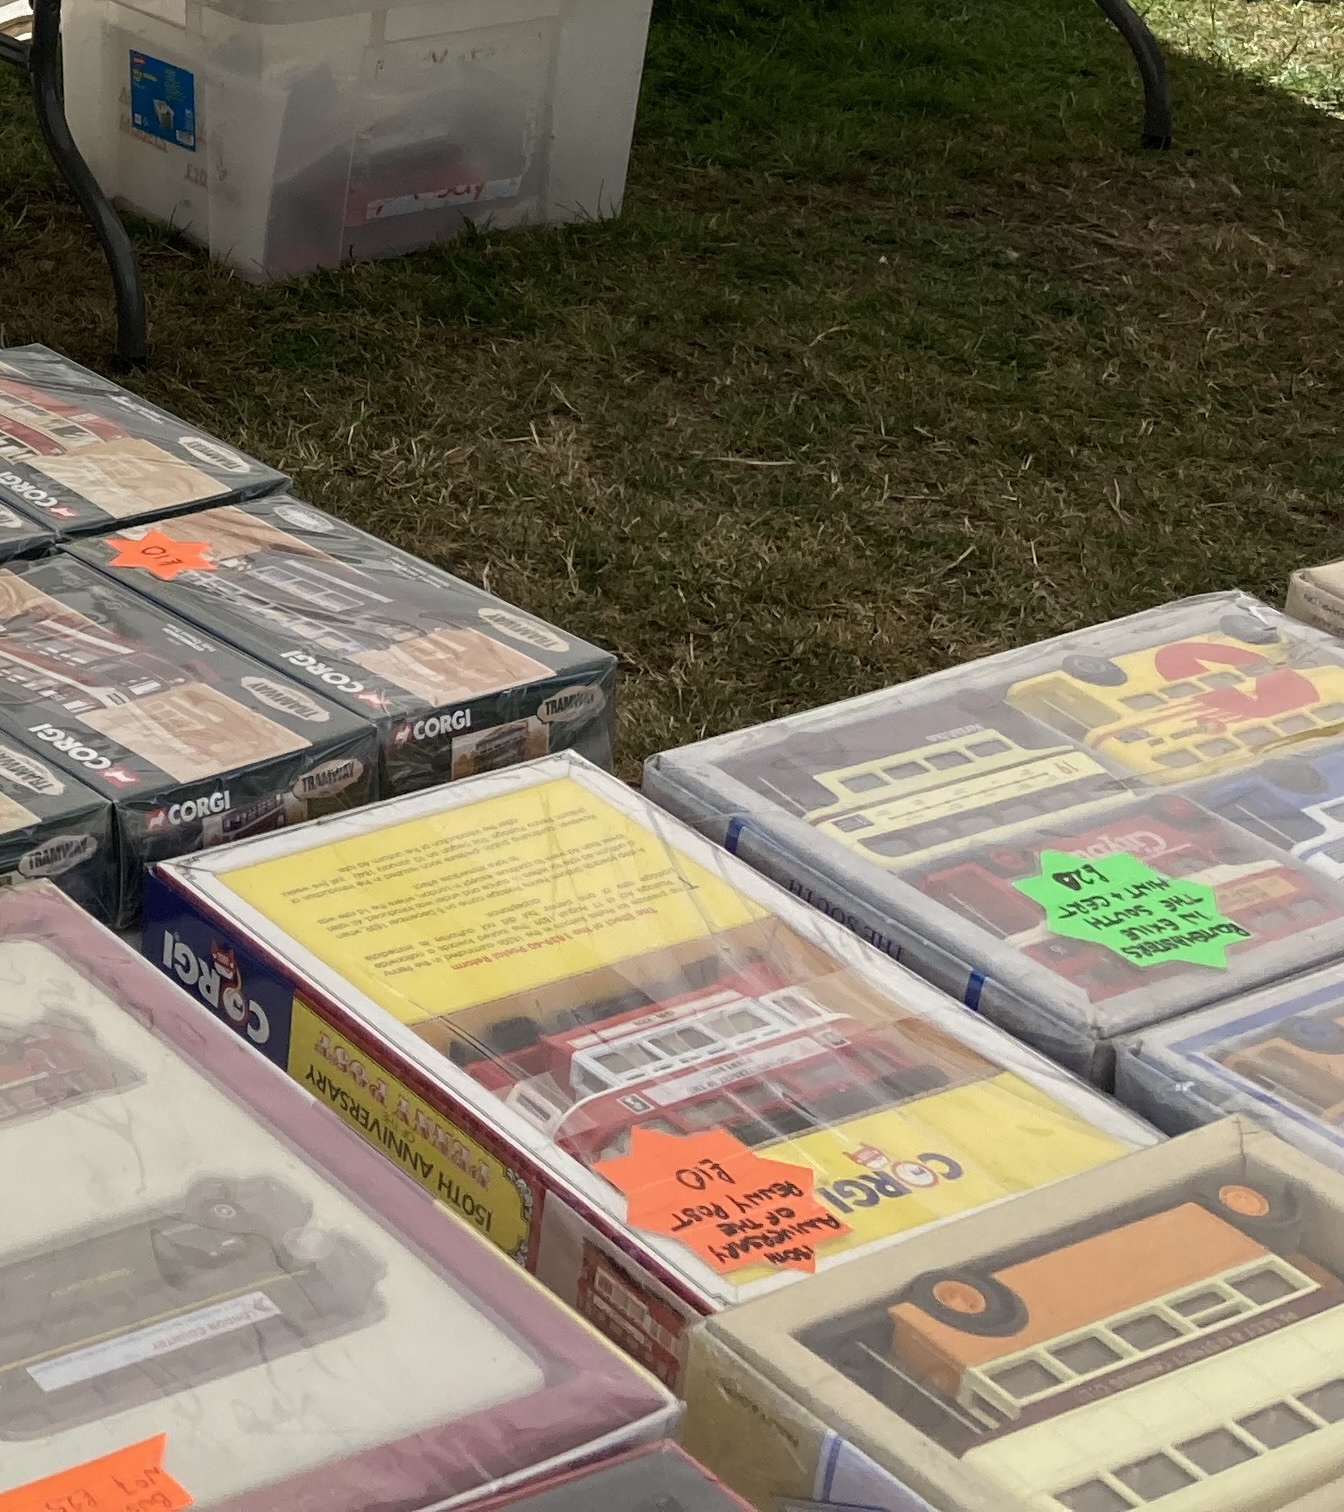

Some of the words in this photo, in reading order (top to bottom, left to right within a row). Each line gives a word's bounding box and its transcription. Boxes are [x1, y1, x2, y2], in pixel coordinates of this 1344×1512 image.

[141, 545, 183, 568] £10
[485, 610, 562, 651] TRAMWAY
[280, 650, 364, 694] CORGI
[247, 678, 323, 721] TRAMWAY
[543, 689, 600, 720] TRAMWAY
[413, 708, 472, 741] CORGI
[27, 722, 112, 771] CORGI
[301, 760, 358, 796] TRAMWAY
[167, 790, 231, 827] CORGI
[1089, 902, 1155, 932] SOUTH
[1158, 893, 1205, 912] THE
[162, 928, 271, 1045] CORGI
[304, 1062, 435, 1185] ANNIVERSARY
[674, 1157, 736, 1190] £10
[817, 1151, 964, 1215] CORGI
[732, 1179, 804, 1214] PENNY
[670, 1201, 731, 1233] POST
[766, 1206, 798, 1227] OF
